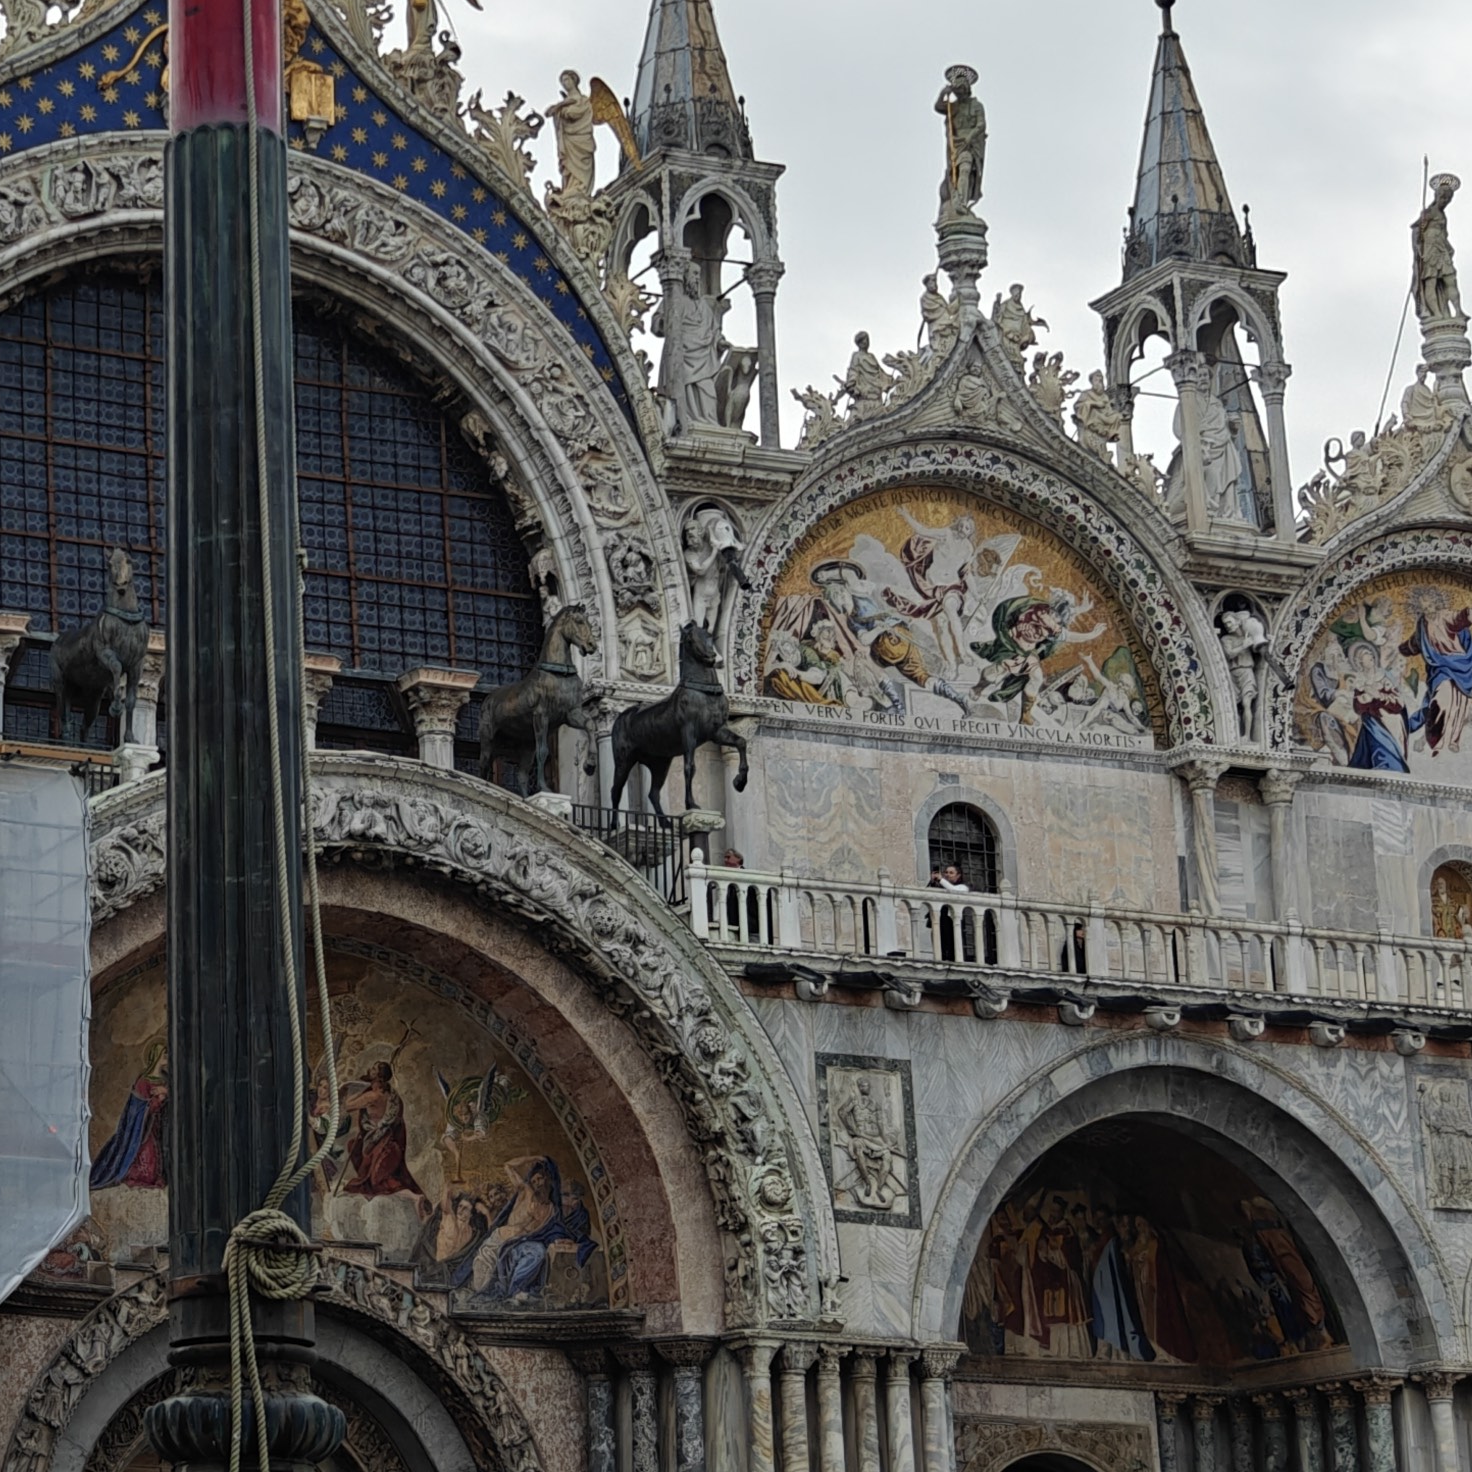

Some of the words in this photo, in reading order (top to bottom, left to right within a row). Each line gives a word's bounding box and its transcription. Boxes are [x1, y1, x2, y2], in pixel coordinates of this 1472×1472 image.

[890, 489, 948, 505] RESVRGO
[774, 700, 794, 715] EN
[806, 704, 853, 721] VERVS
[863, 710, 905, 727] FORTIS
[914, 716, 940, 731] QVI
[952, 719, 1001, 735] FREGIT
[1008, 724, 1075, 744] VINCVLA
